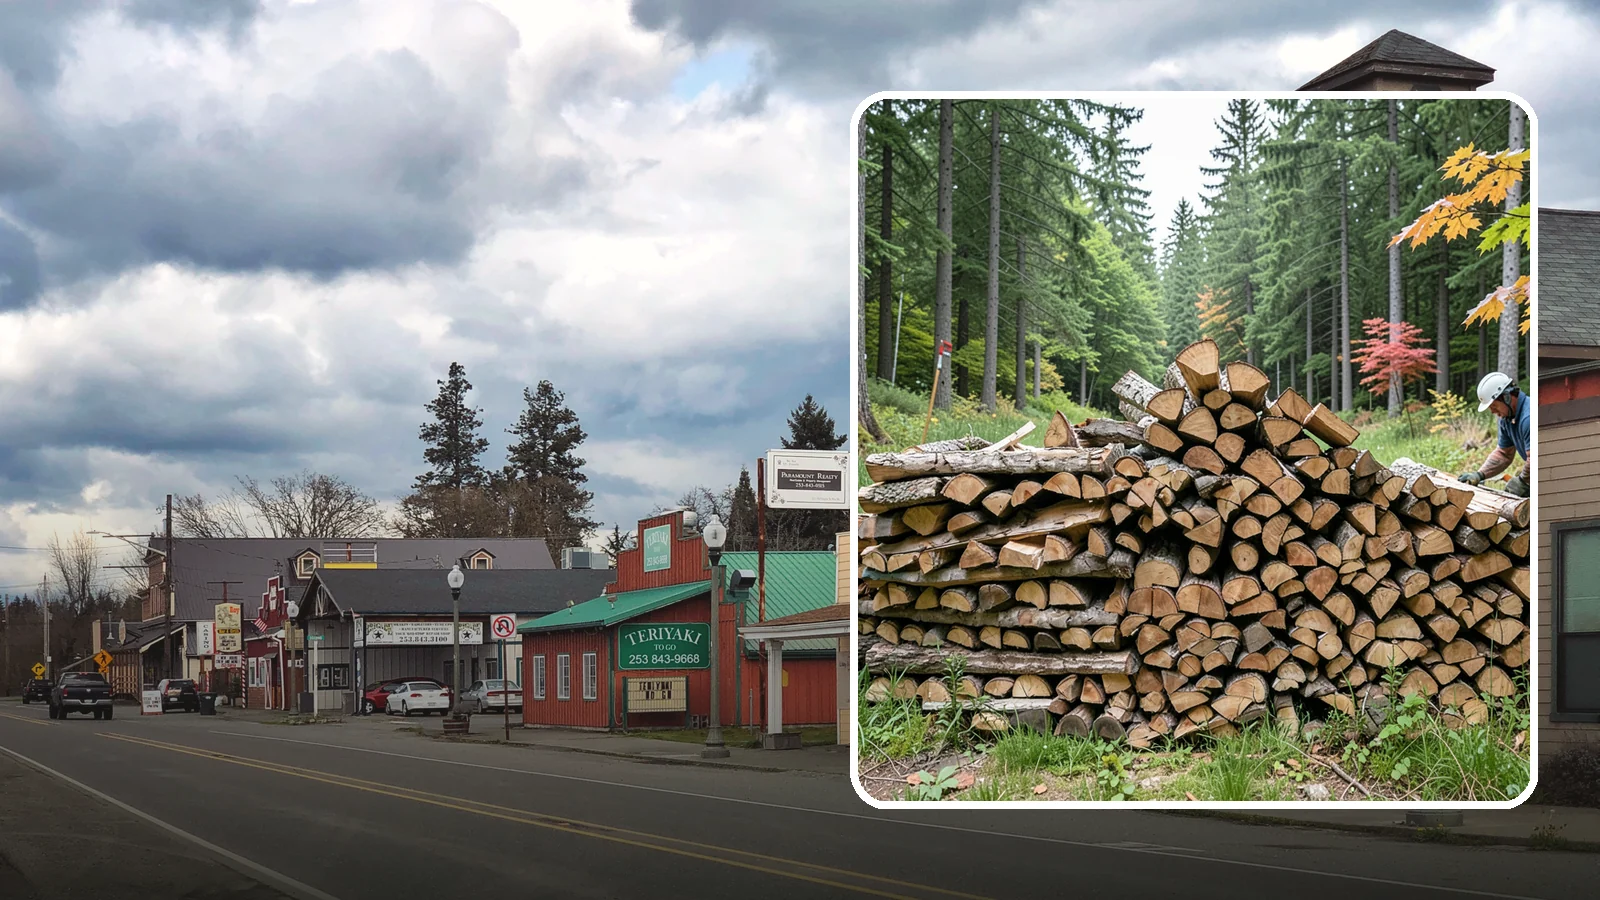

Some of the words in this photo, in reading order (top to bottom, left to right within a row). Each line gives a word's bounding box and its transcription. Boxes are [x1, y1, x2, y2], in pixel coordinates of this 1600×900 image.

[625, 628, 702, 646] TERIYAKI
[629, 654, 648, 664] 253
[652, 654, 700, 664] 843-9668
